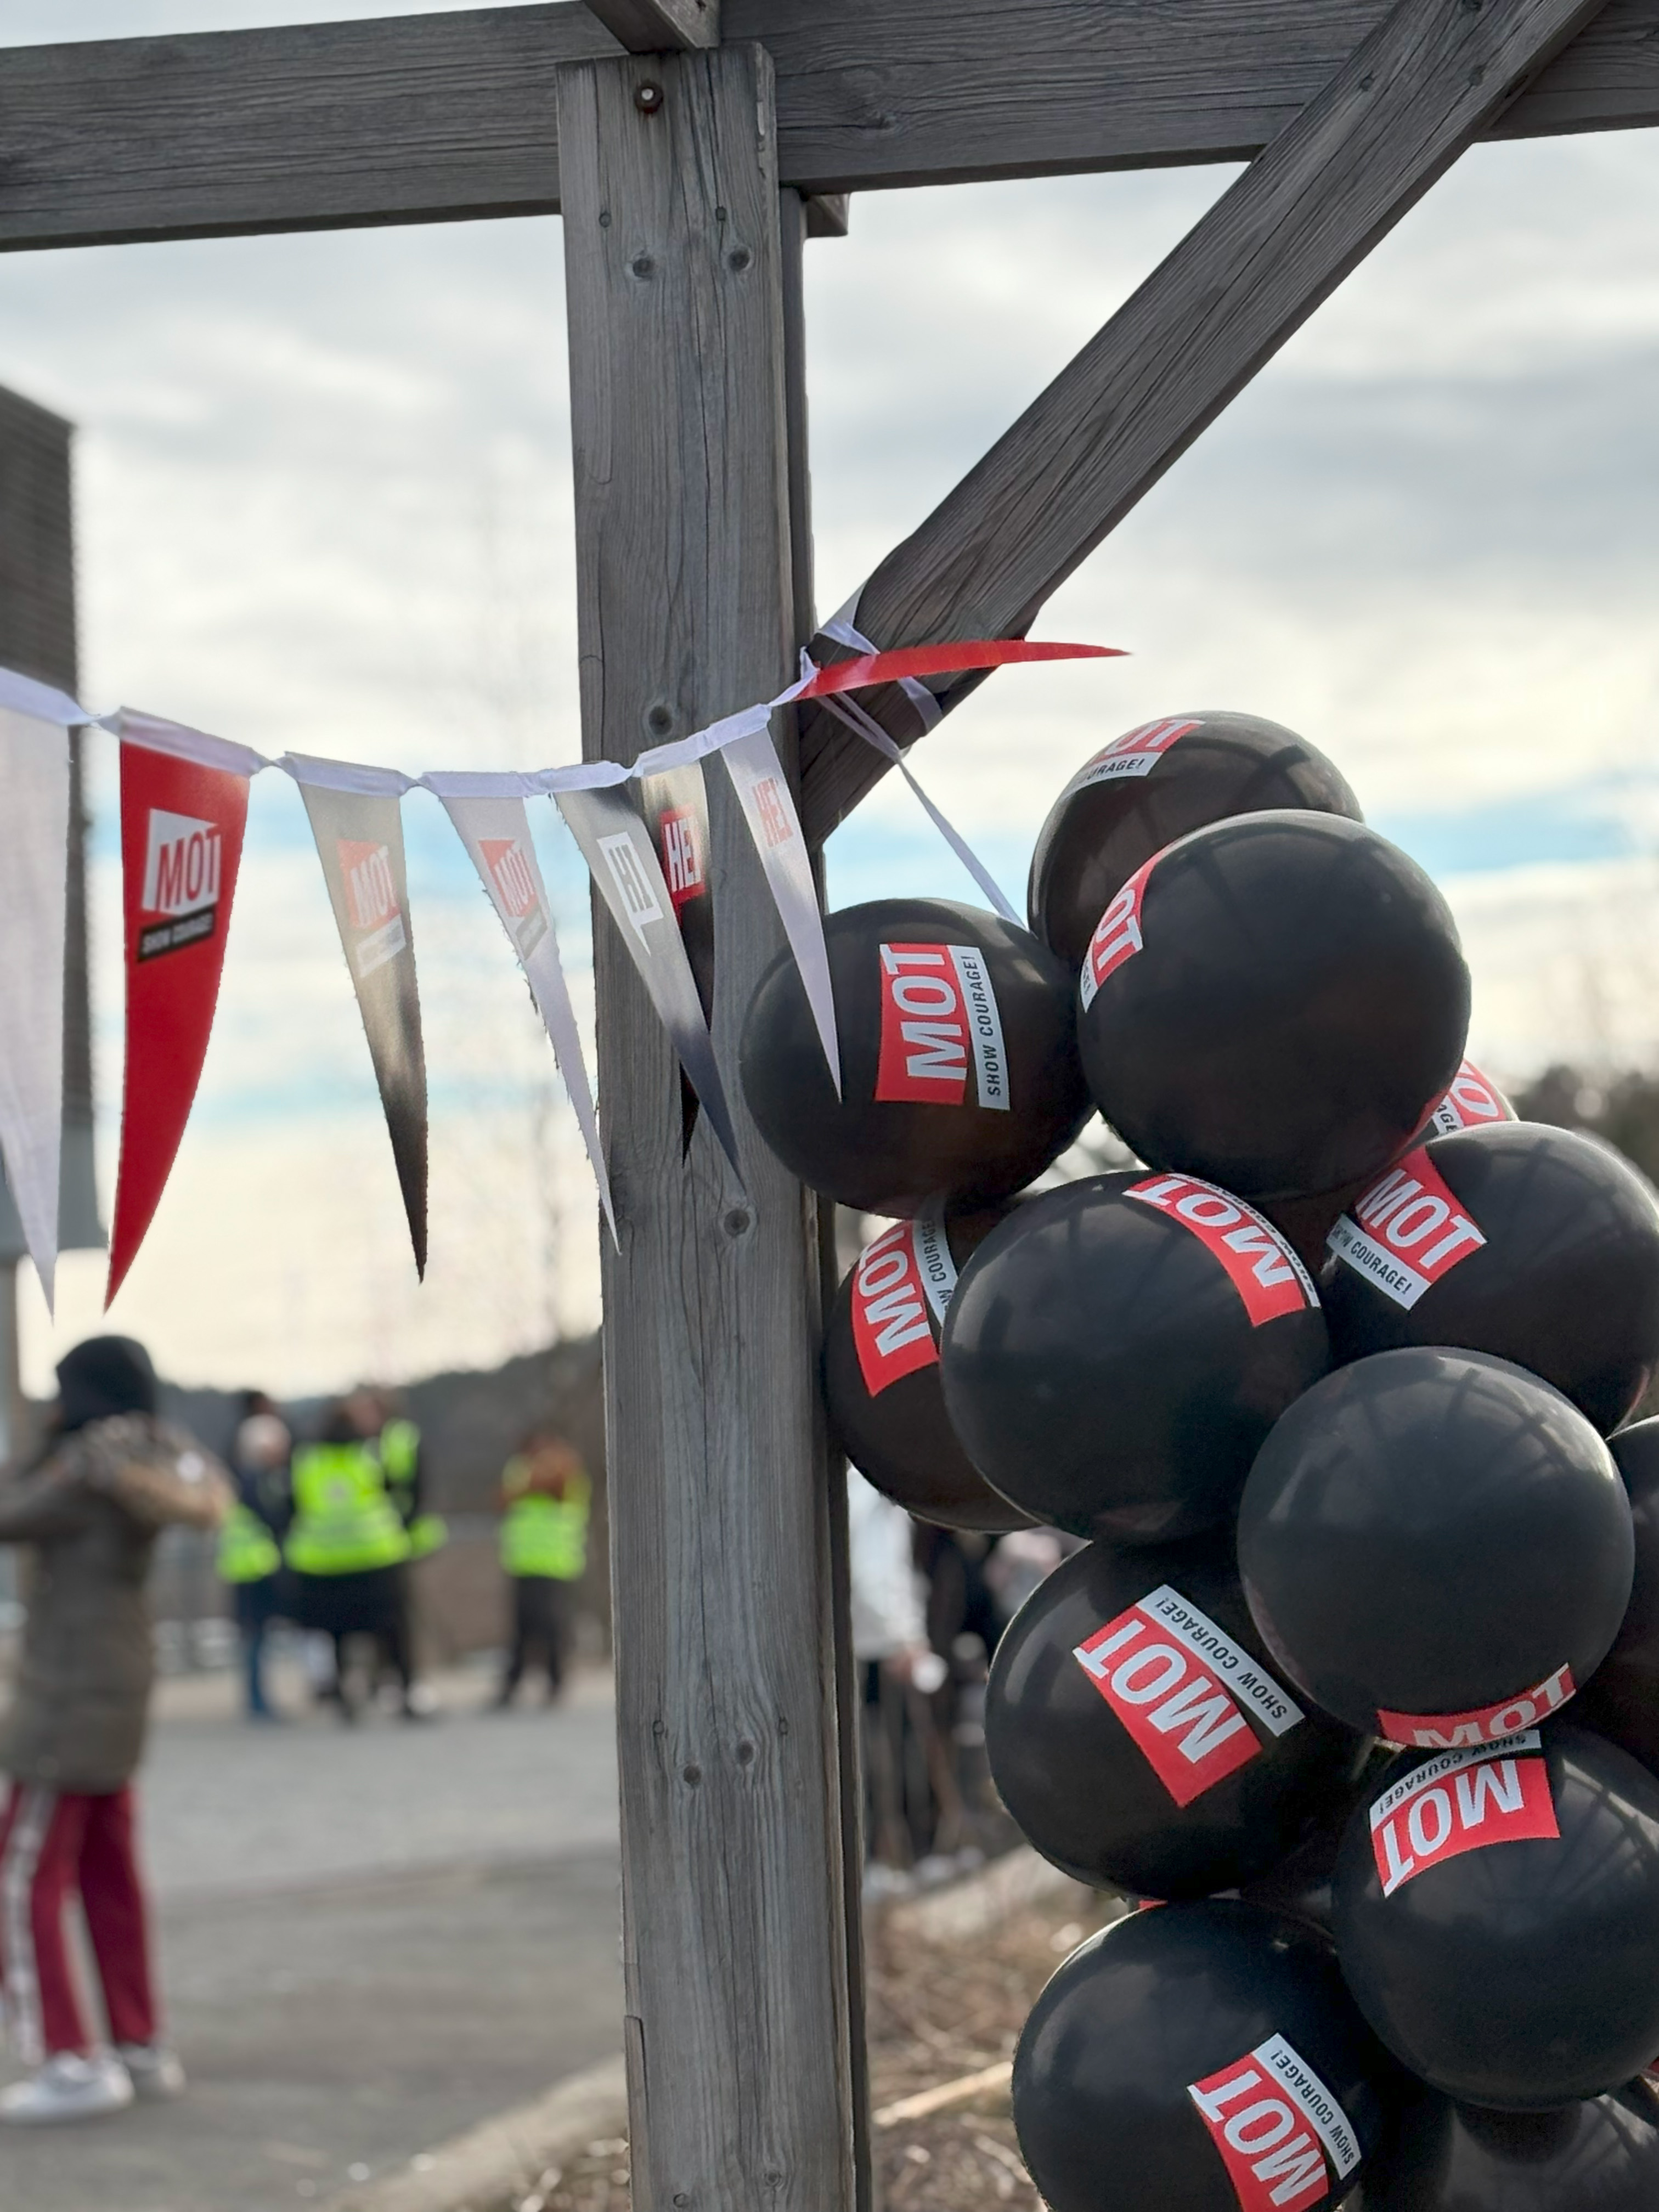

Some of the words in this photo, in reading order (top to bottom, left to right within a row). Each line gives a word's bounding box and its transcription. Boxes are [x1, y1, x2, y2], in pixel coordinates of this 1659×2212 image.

[154, 825, 221, 911] MOT
[350, 845, 397, 928] MOT
[494, 848, 535, 918] MOT
[879, 944, 967, 1081] MOT
[961, 955, 994, 1037] COURAGE!
[983, 1045, 1001, 1096] SHOW
[922, 1220, 947, 1283] COURAGE
[1121, 1179, 1295, 1288] MOT
[1355, 1168, 1488, 1269] MOT
[859, 1229, 931, 1357] MOT
[1350, 1241, 1412, 1295] COURAGE!
[1154, 1597, 1239, 1670] COURAGE!
[1072, 1618, 1247, 1764] MOT
[1237, 1672, 1288, 1719] SHOW
[1413, 1662, 1570, 1747] MOT
[1379, 1753, 1464, 1815] COURAGE!
[1381, 1759, 1525, 1898] MOT
[1271, 2049, 1334, 2125] COURAGE!
[1186, 2069, 1327, 2207] MOT
[1329, 2124, 1355, 2165] SHOW
